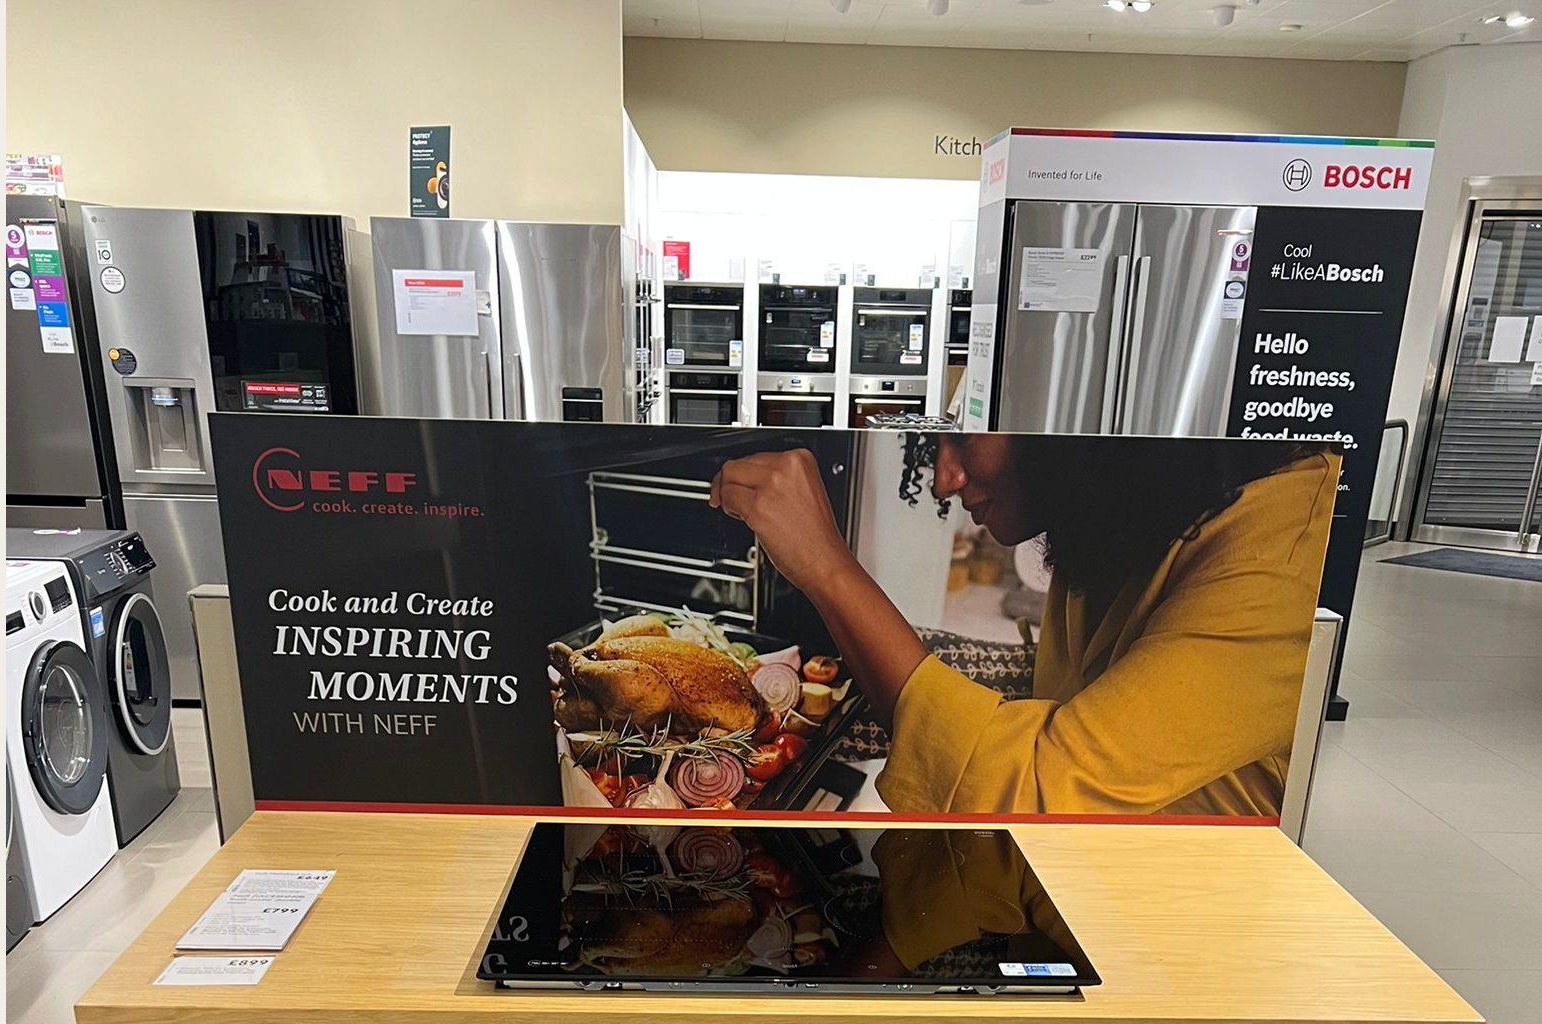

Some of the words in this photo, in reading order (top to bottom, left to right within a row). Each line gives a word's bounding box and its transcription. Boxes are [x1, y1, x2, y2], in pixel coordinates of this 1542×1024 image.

[934, 135, 982, 155] Kitch
[1028, 169, 1067, 180] Invented
[1070, 170, 1083, 181] for
[1085, 171, 1103, 181] Life
[1324, 164, 1412, 190] BOSCH
[1283, 244, 1313, 258] Cool
[1270, 263, 1384, 283] #LikeABosch
[1254, 333, 1309, 354] Hello
[1249, 364, 1356, 391] freshness,
[1243, 397, 1334, 422] goodbye
[312, 500, 357, 513] cook.
[362, 502, 418, 515] create.
[423, 502, 485, 518] inspire.
[268, 589, 337, 613] Cook
[344, 591, 398, 614] and
[407, 592, 494, 617] Create
[273, 625, 492, 660] INSPIRING
[307, 671, 518, 704] MOMENTS
[293, 711, 364, 734] WITH
[373, 713, 437, 735] NEFF
